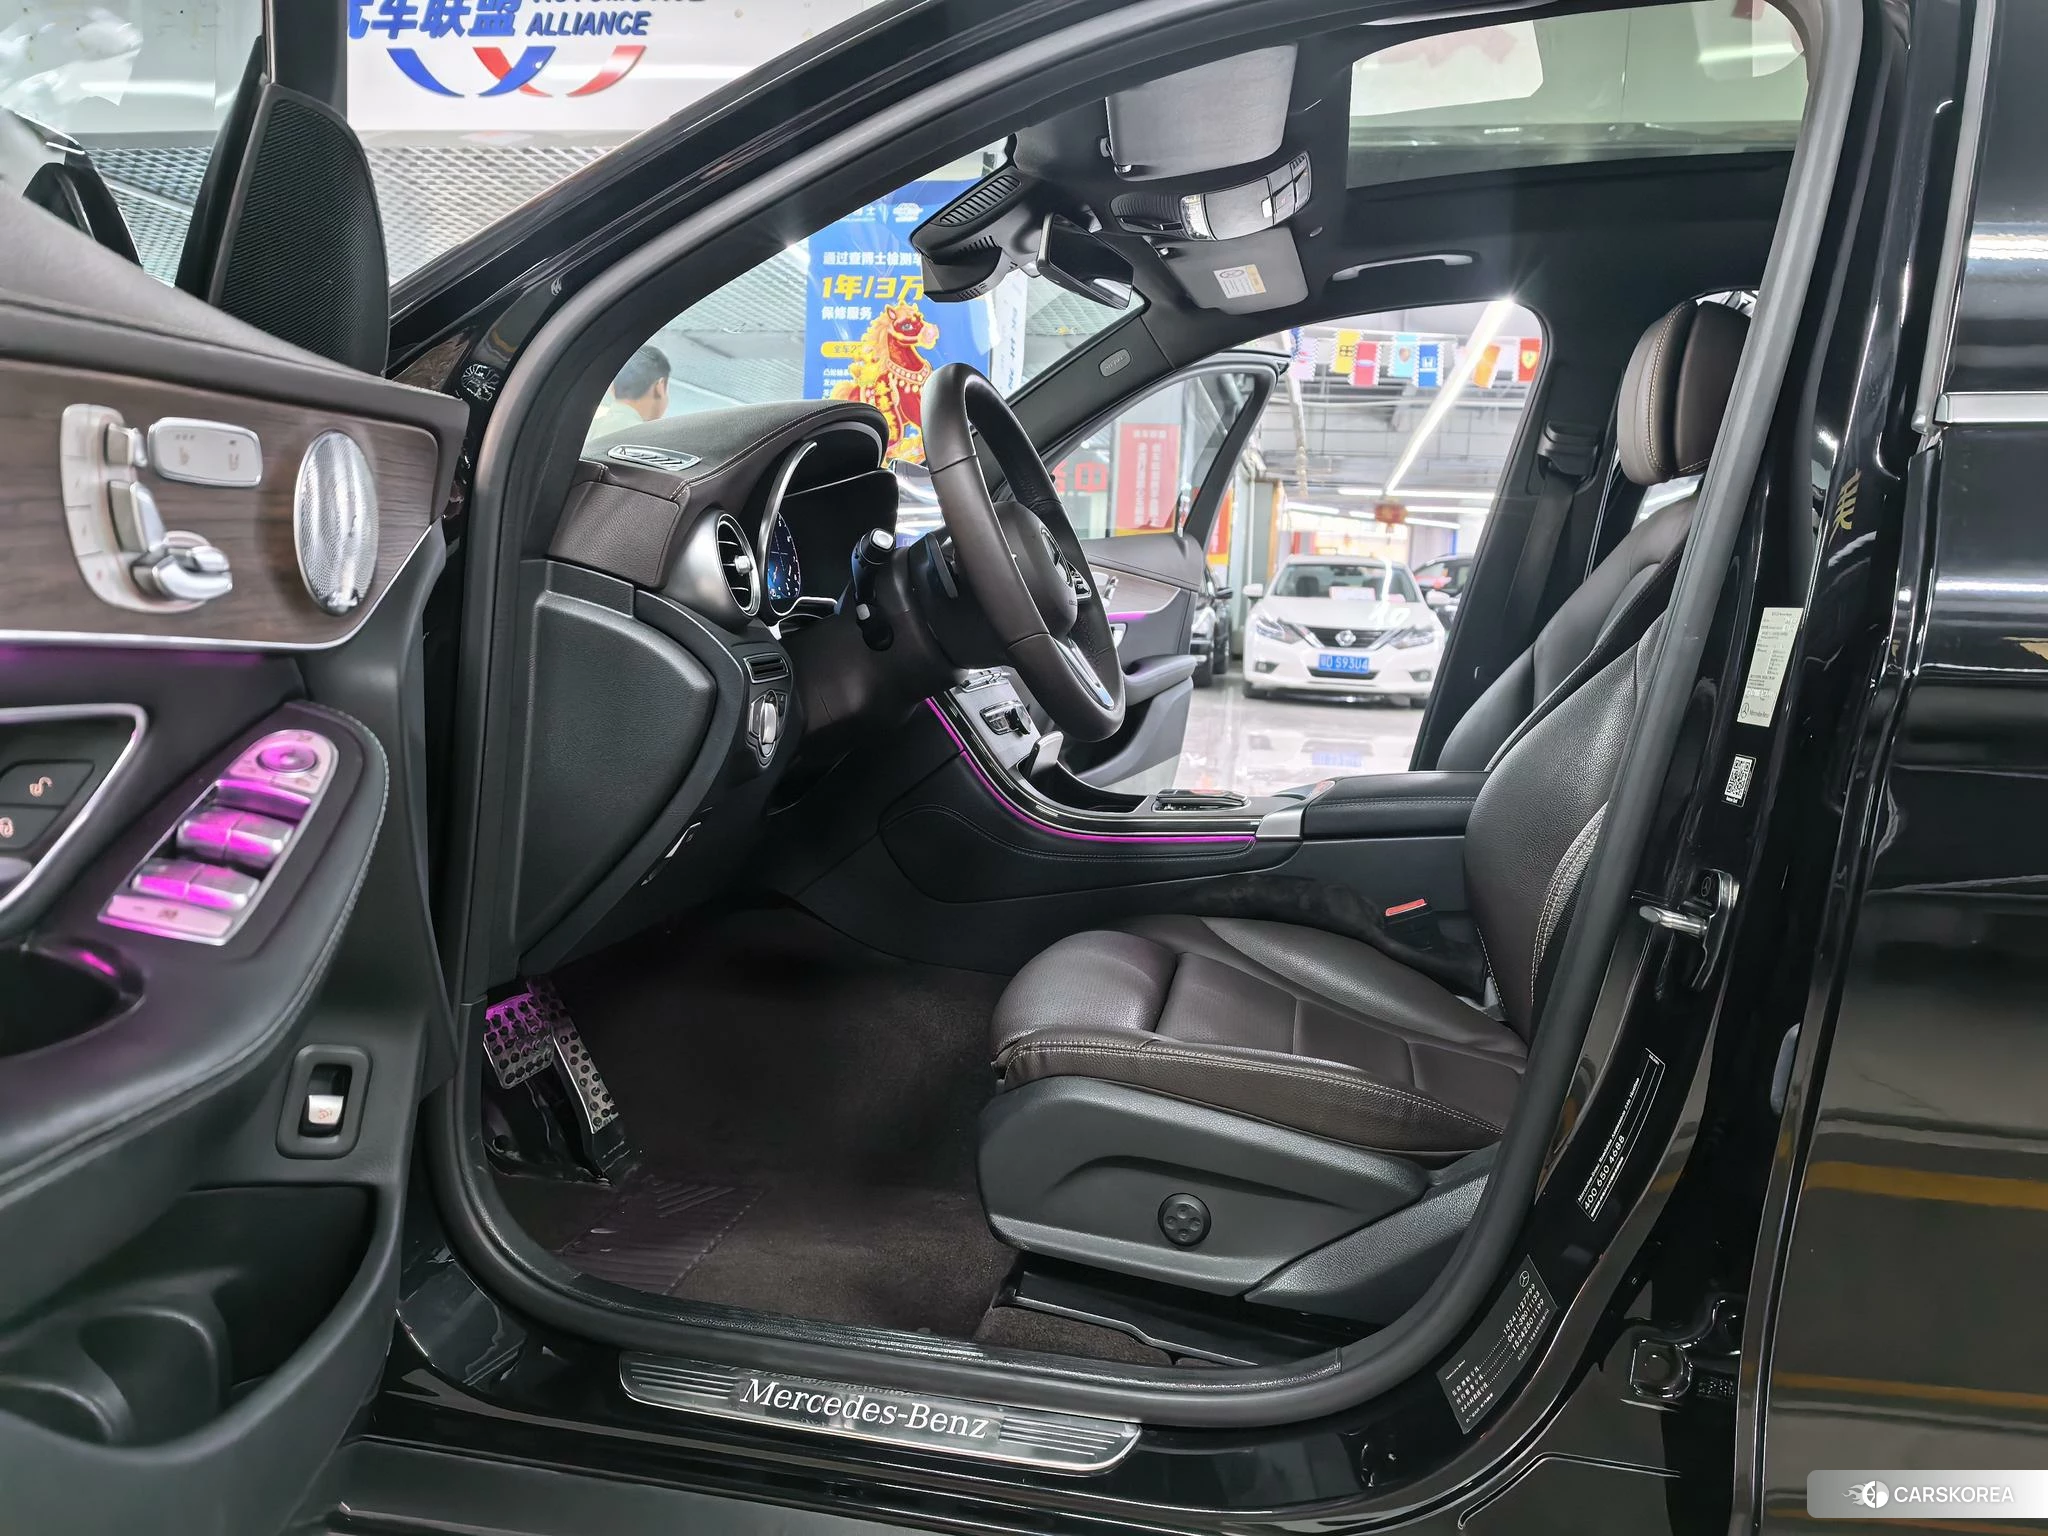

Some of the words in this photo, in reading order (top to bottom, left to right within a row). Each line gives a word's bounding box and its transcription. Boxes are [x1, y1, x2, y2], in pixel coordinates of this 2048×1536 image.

[526, 11, 652, 36] ALLIANCE
[822, 274, 924, 301] 1年/3万
[1584, 1187, 1598, 1210] 400
[1597, 1164, 1610, 1187] 650
[1609, 1135, 1625, 1164] 4688
[738, 1378, 990, 1439] Mercedes-Benz
